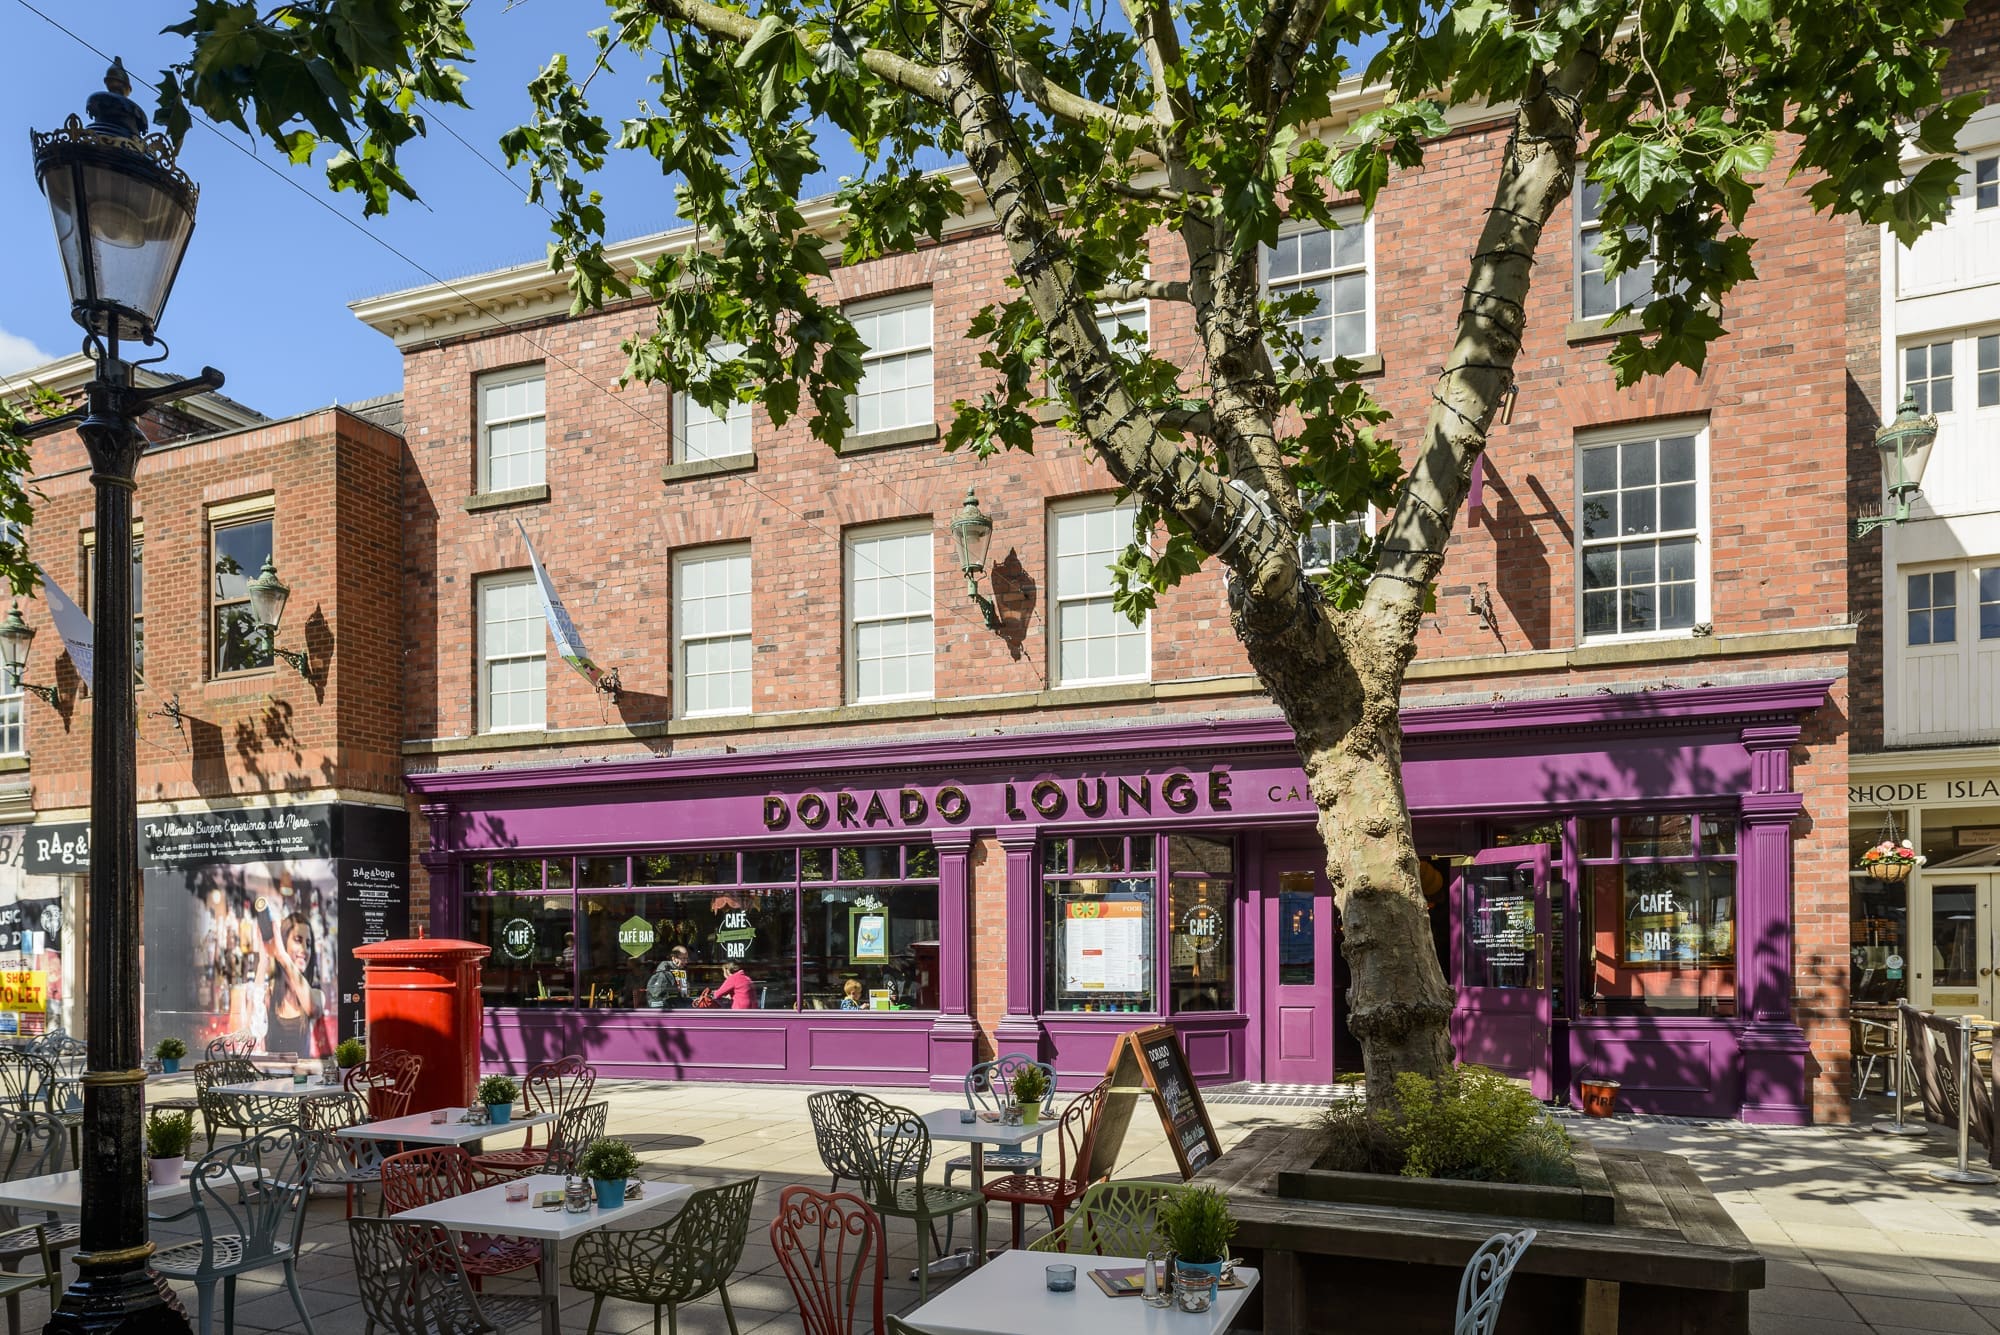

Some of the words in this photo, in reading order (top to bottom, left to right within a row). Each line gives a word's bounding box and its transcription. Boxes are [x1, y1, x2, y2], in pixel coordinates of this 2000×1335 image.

[763, 786, 966, 826] DORADO
[1005, 770, 1232, 815] LOUNGE
[144, 823, 163, 838] The
[163, 822, 195, 837] Ultimate
[195, 821, 223, 838] Burger
[224, 818, 267, 838] Experience
[268, 814, 285, 829] and
[1640, 889, 1674, 913] CAFÉ
[725, 910, 747, 928] CAFÉ
[1189, 915, 1216, 936] CAFÉ
[508, 926, 529, 945] CAFÉ
[618, 927, 638, 943] CAFÉ
[639, 930, 655, 943] BAR
[1643, 931, 1671, 951] BAR
[727, 942, 745, 958] BAR
[6, 972, 32, 984] SHOP
[18, 986, 41, 1003] LET
[1148, 1045, 1170, 1063] DORADO
